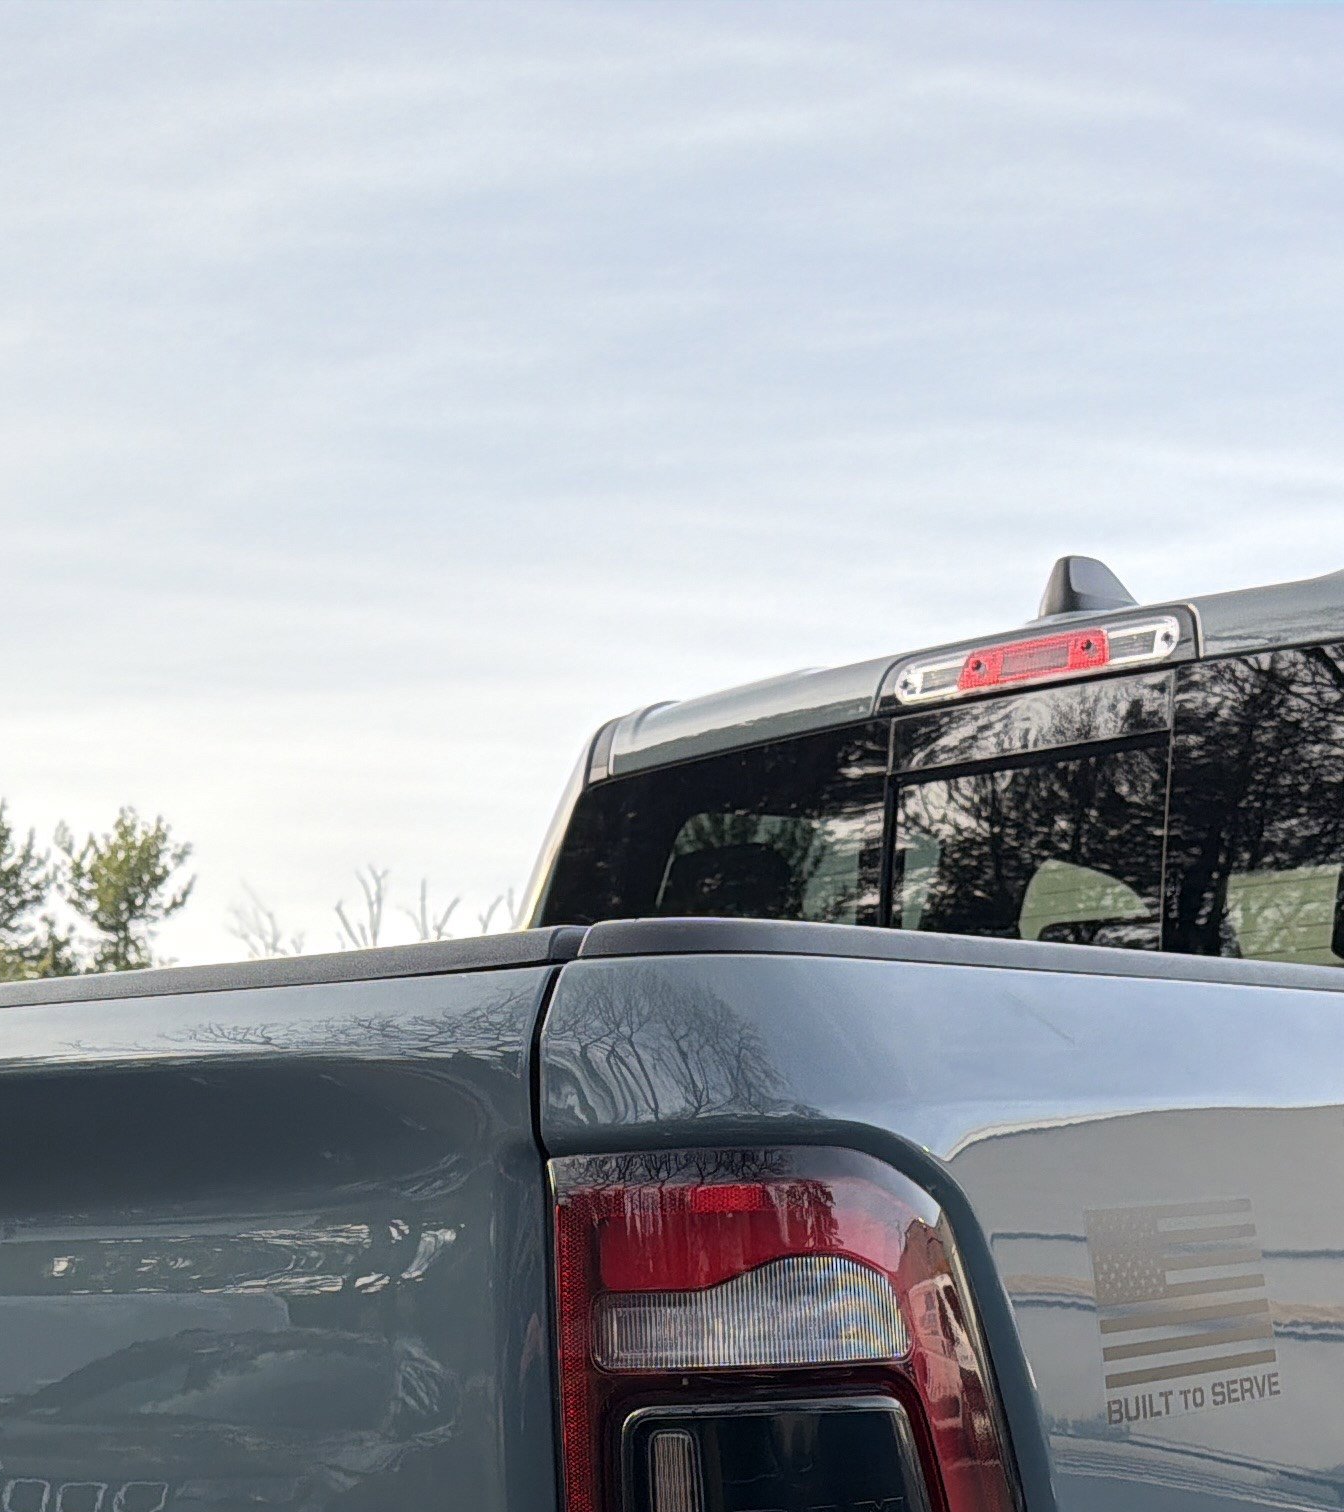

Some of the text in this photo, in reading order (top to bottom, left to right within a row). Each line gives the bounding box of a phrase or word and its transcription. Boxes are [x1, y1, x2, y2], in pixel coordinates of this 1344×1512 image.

[1107, 1371, 1282, 1426] BUILT TO SERVE
